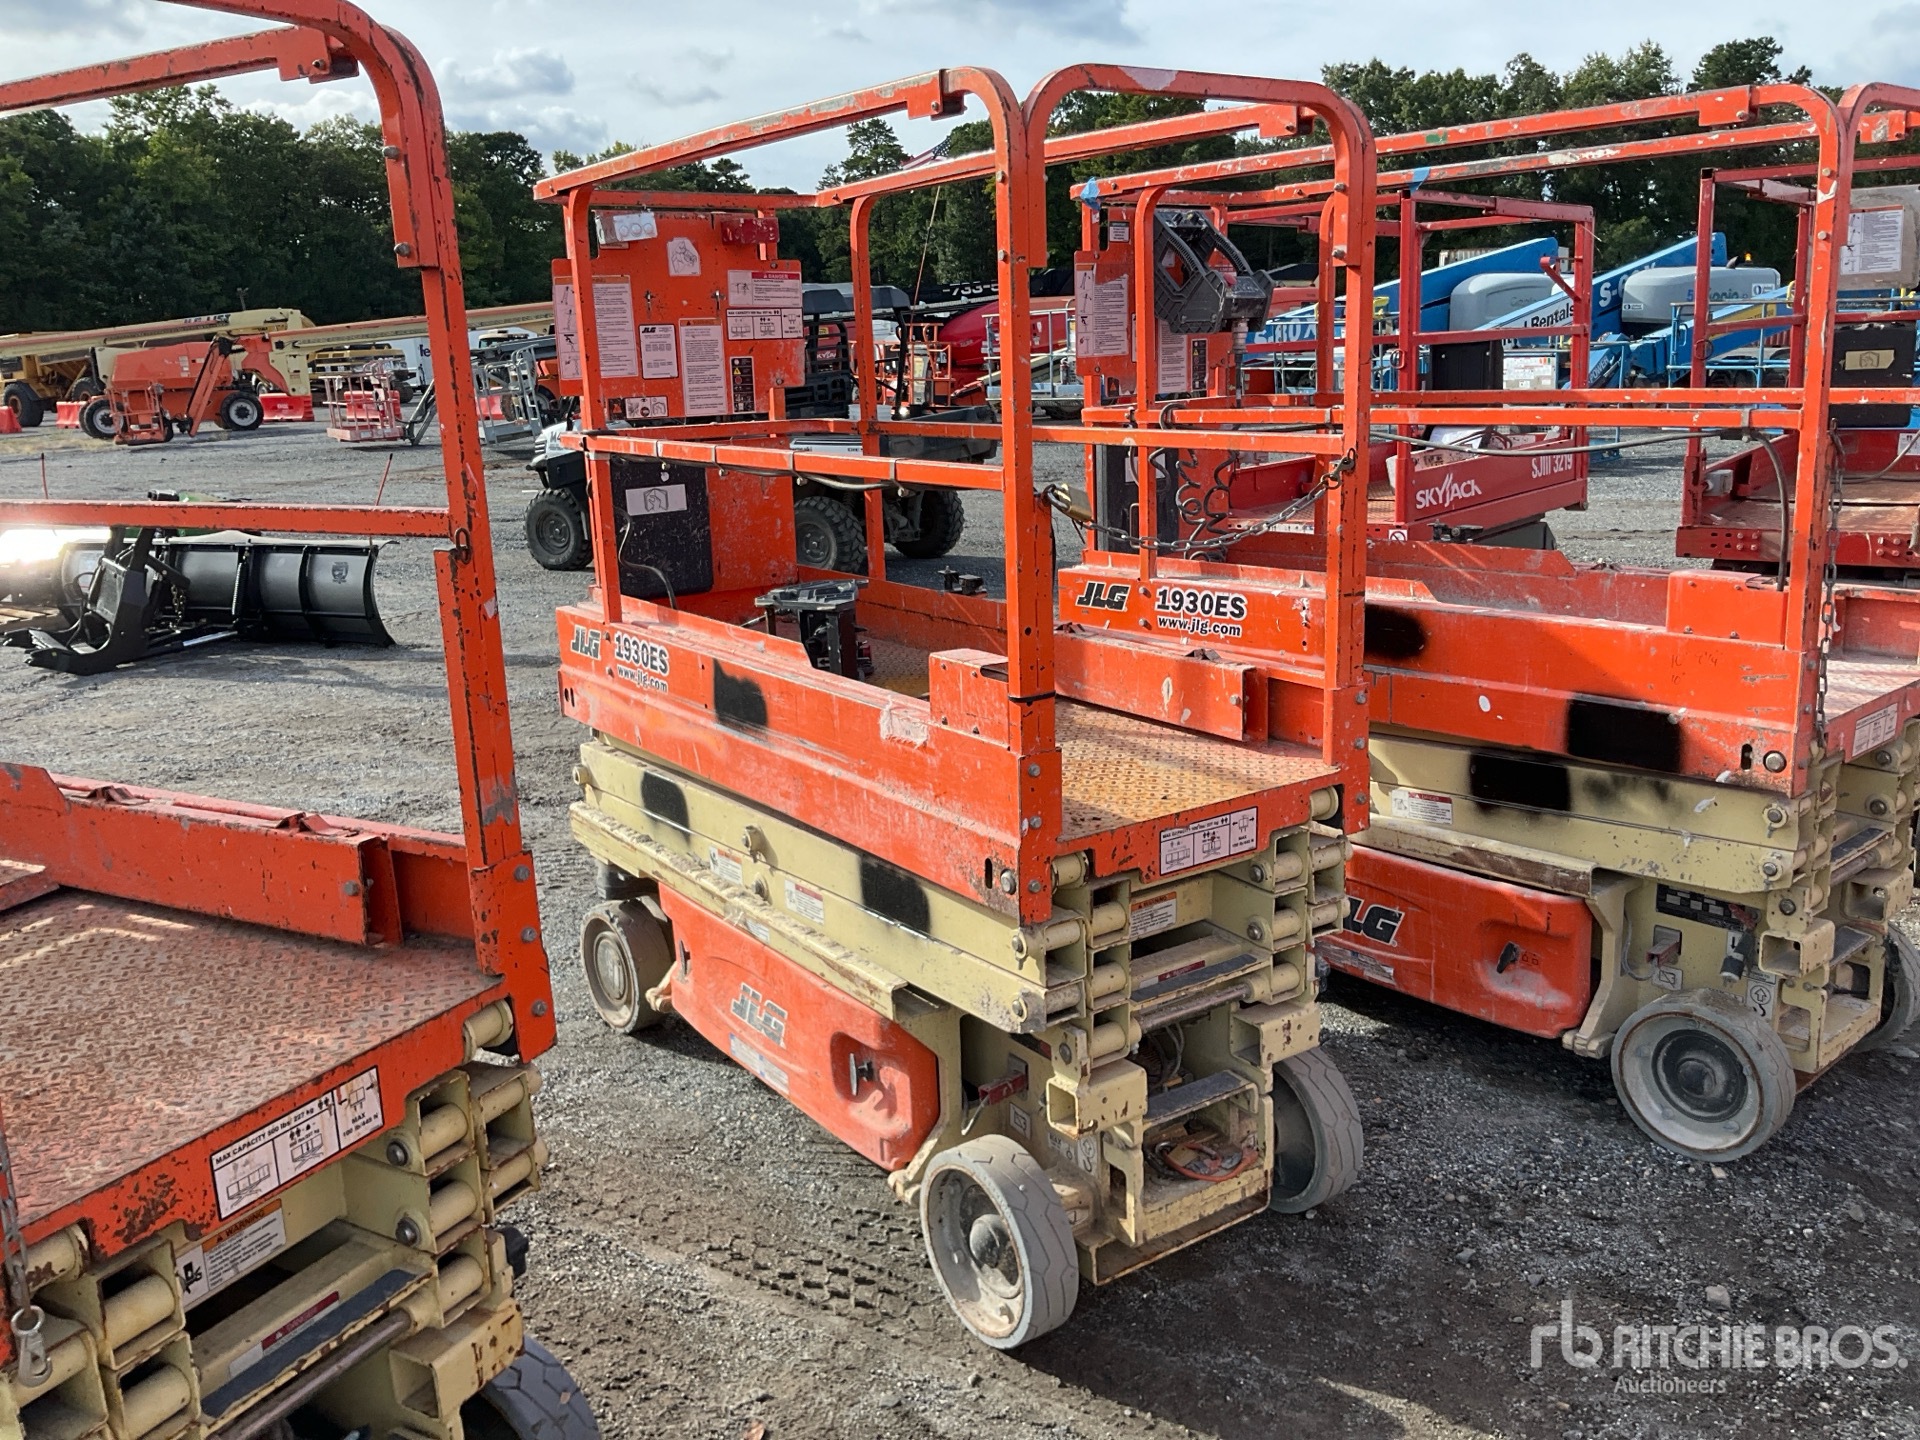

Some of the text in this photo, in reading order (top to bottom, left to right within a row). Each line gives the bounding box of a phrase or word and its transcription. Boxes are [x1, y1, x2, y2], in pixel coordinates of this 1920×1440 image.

[1553, 453, 1573, 473] 3219
[1415, 473, 1482, 510] SKYJACK
[1075, 580, 1247, 620] JLG 1930ES
[1157, 615, 1242, 637] www.jlg.com
[571, 624, 670, 676] JLG 1930ES
[617, 664, 669, 693] www.jlg.com
[1343, 895, 1405, 946] LG
[730, 981, 788, 1047] JLG
[351, 1112, 366, 1124] MAX
[215, 1151, 233, 1165] MAX
[232, 1133, 266, 1155] CAPACITY
[225, 1209, 265, 1236] WARNING
